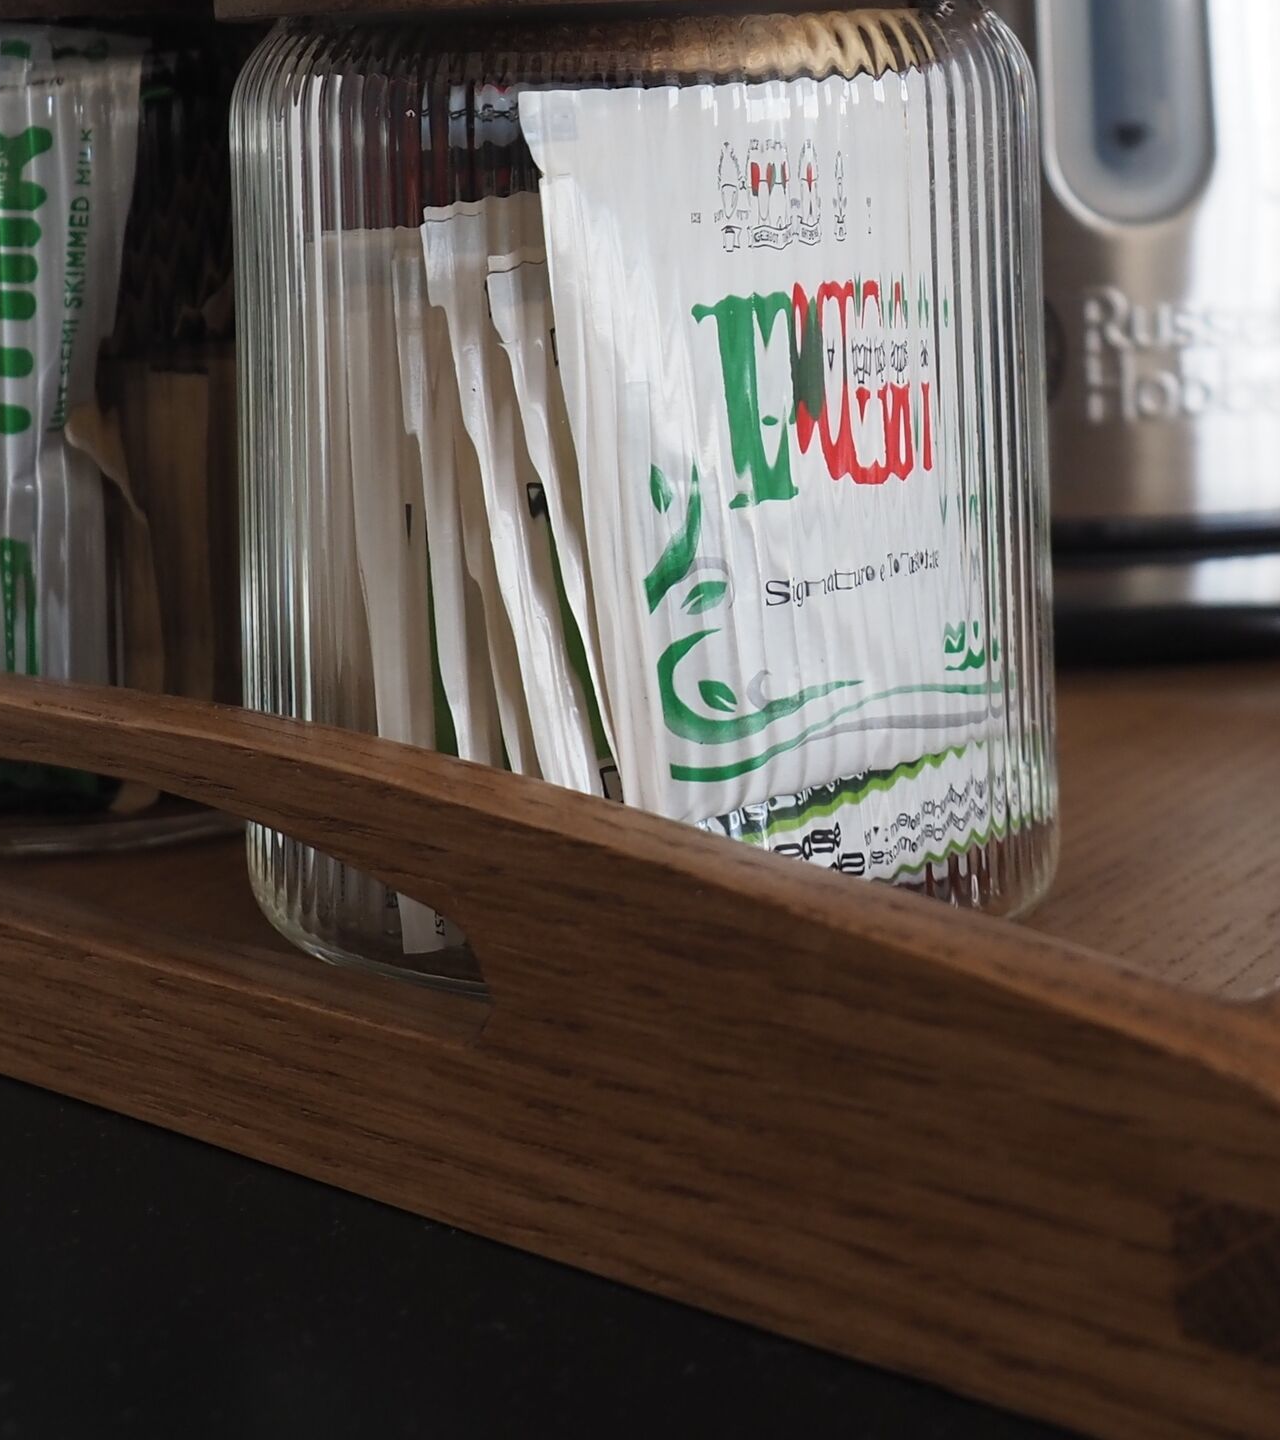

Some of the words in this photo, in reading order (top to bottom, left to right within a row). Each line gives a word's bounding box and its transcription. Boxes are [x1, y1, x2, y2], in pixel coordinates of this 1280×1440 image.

[74, 127, 93, 186] MILK
[63, 195, 91, 310] SKIMMED
[57, 319, 80, 376] SEMI
